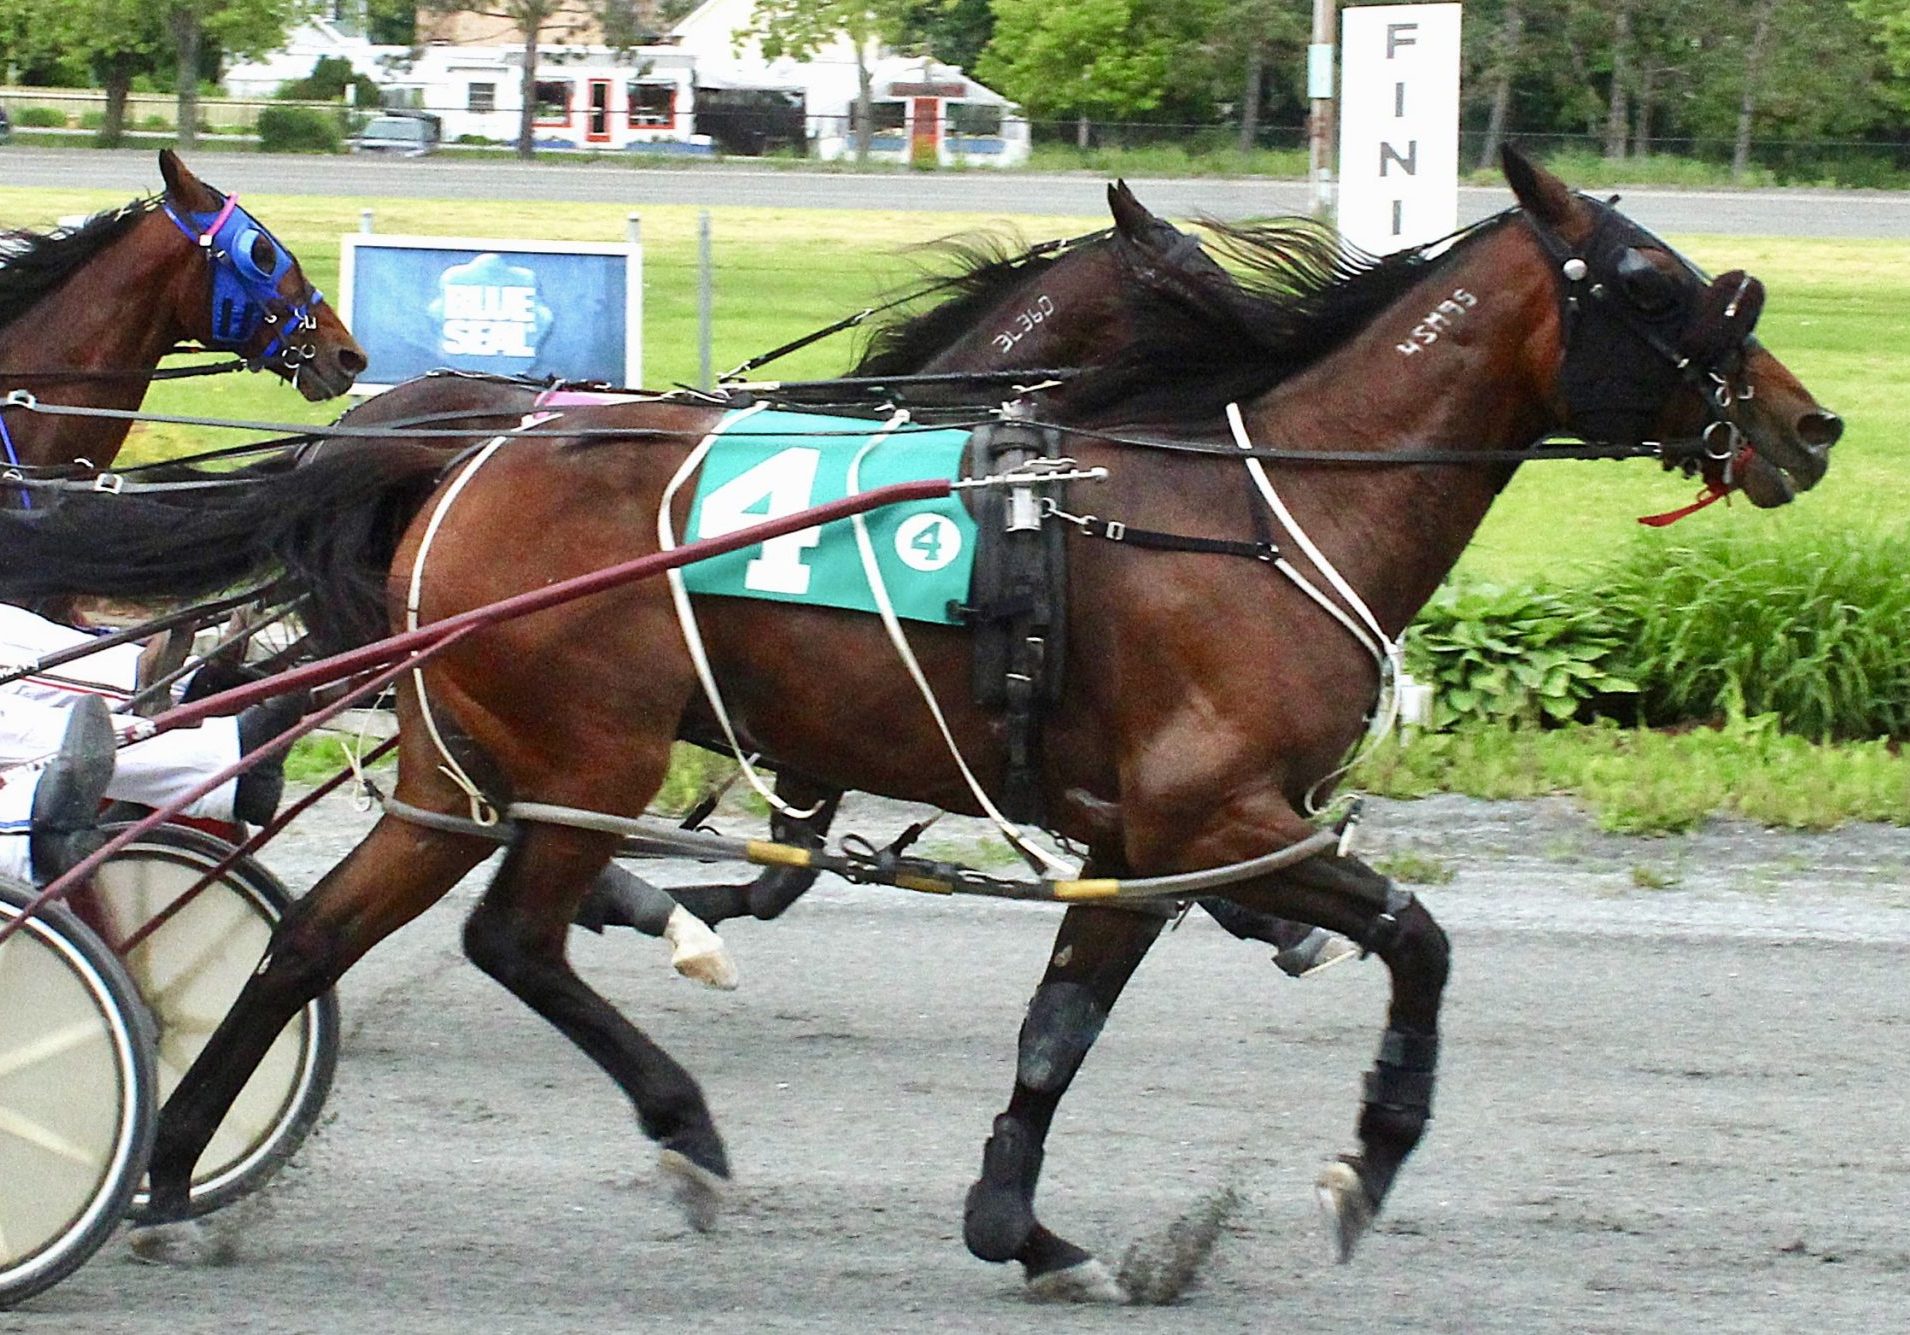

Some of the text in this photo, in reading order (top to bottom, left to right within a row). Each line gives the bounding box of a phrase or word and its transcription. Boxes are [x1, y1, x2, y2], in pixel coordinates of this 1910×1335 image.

[444, 284, 536, 320] BLUE
[443, 320, 537, 357] SEAL
[699, 447, 820, 594] 4
[911, 521, 942, 560] 4
